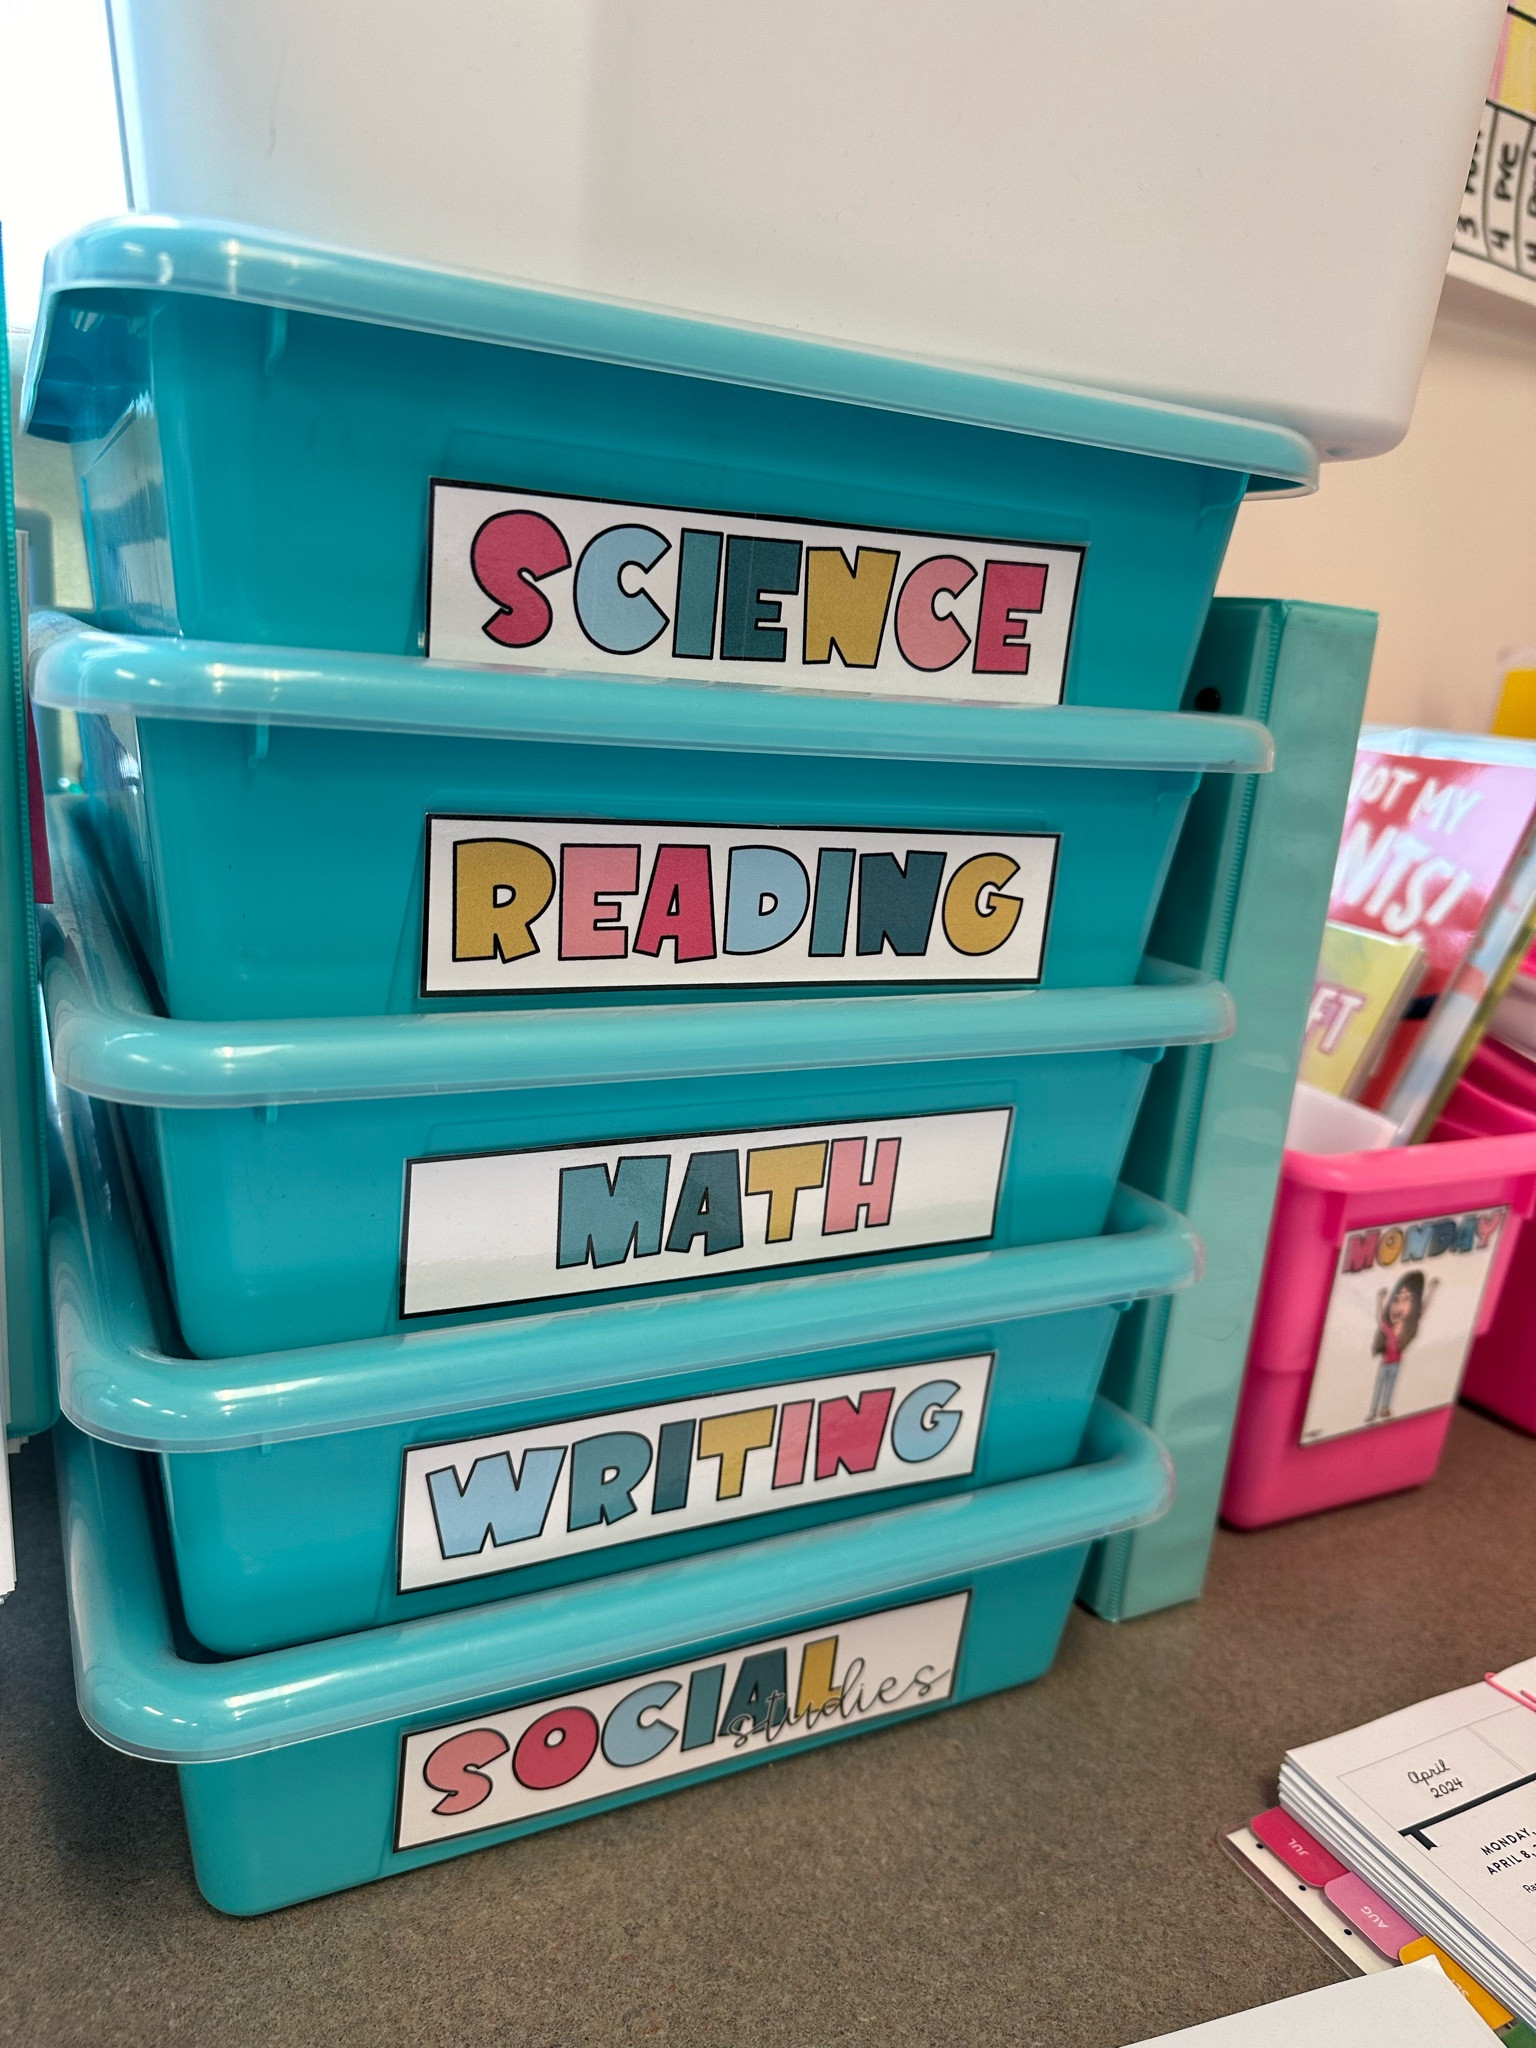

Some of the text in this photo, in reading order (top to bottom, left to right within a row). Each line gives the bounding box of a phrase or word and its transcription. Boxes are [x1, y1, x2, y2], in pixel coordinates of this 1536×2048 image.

[470, 509, 1050, 675] SCIENCE
[1407, 777, 1483, 836] MY
[452, 837, 1024, 965] READING
[556, 1136, 902, 1270] MATH
[1341, 1208, 1506, 1274] MONDAY
[425, 1379, 963, 1560] WRITING
[423, 1634, 841, 1815] SOCIAL
[727, 1657, 951, 1748] studies
[1407, 1758, 1451, 1786] April
[1430, 1777, 1464, 1798] 2024
[1287, 1837, 1309, 1856] JUL
[1486, 1854, 1522, 1875] APRIL
[1360, 1905, 1389, 1929] AUG
